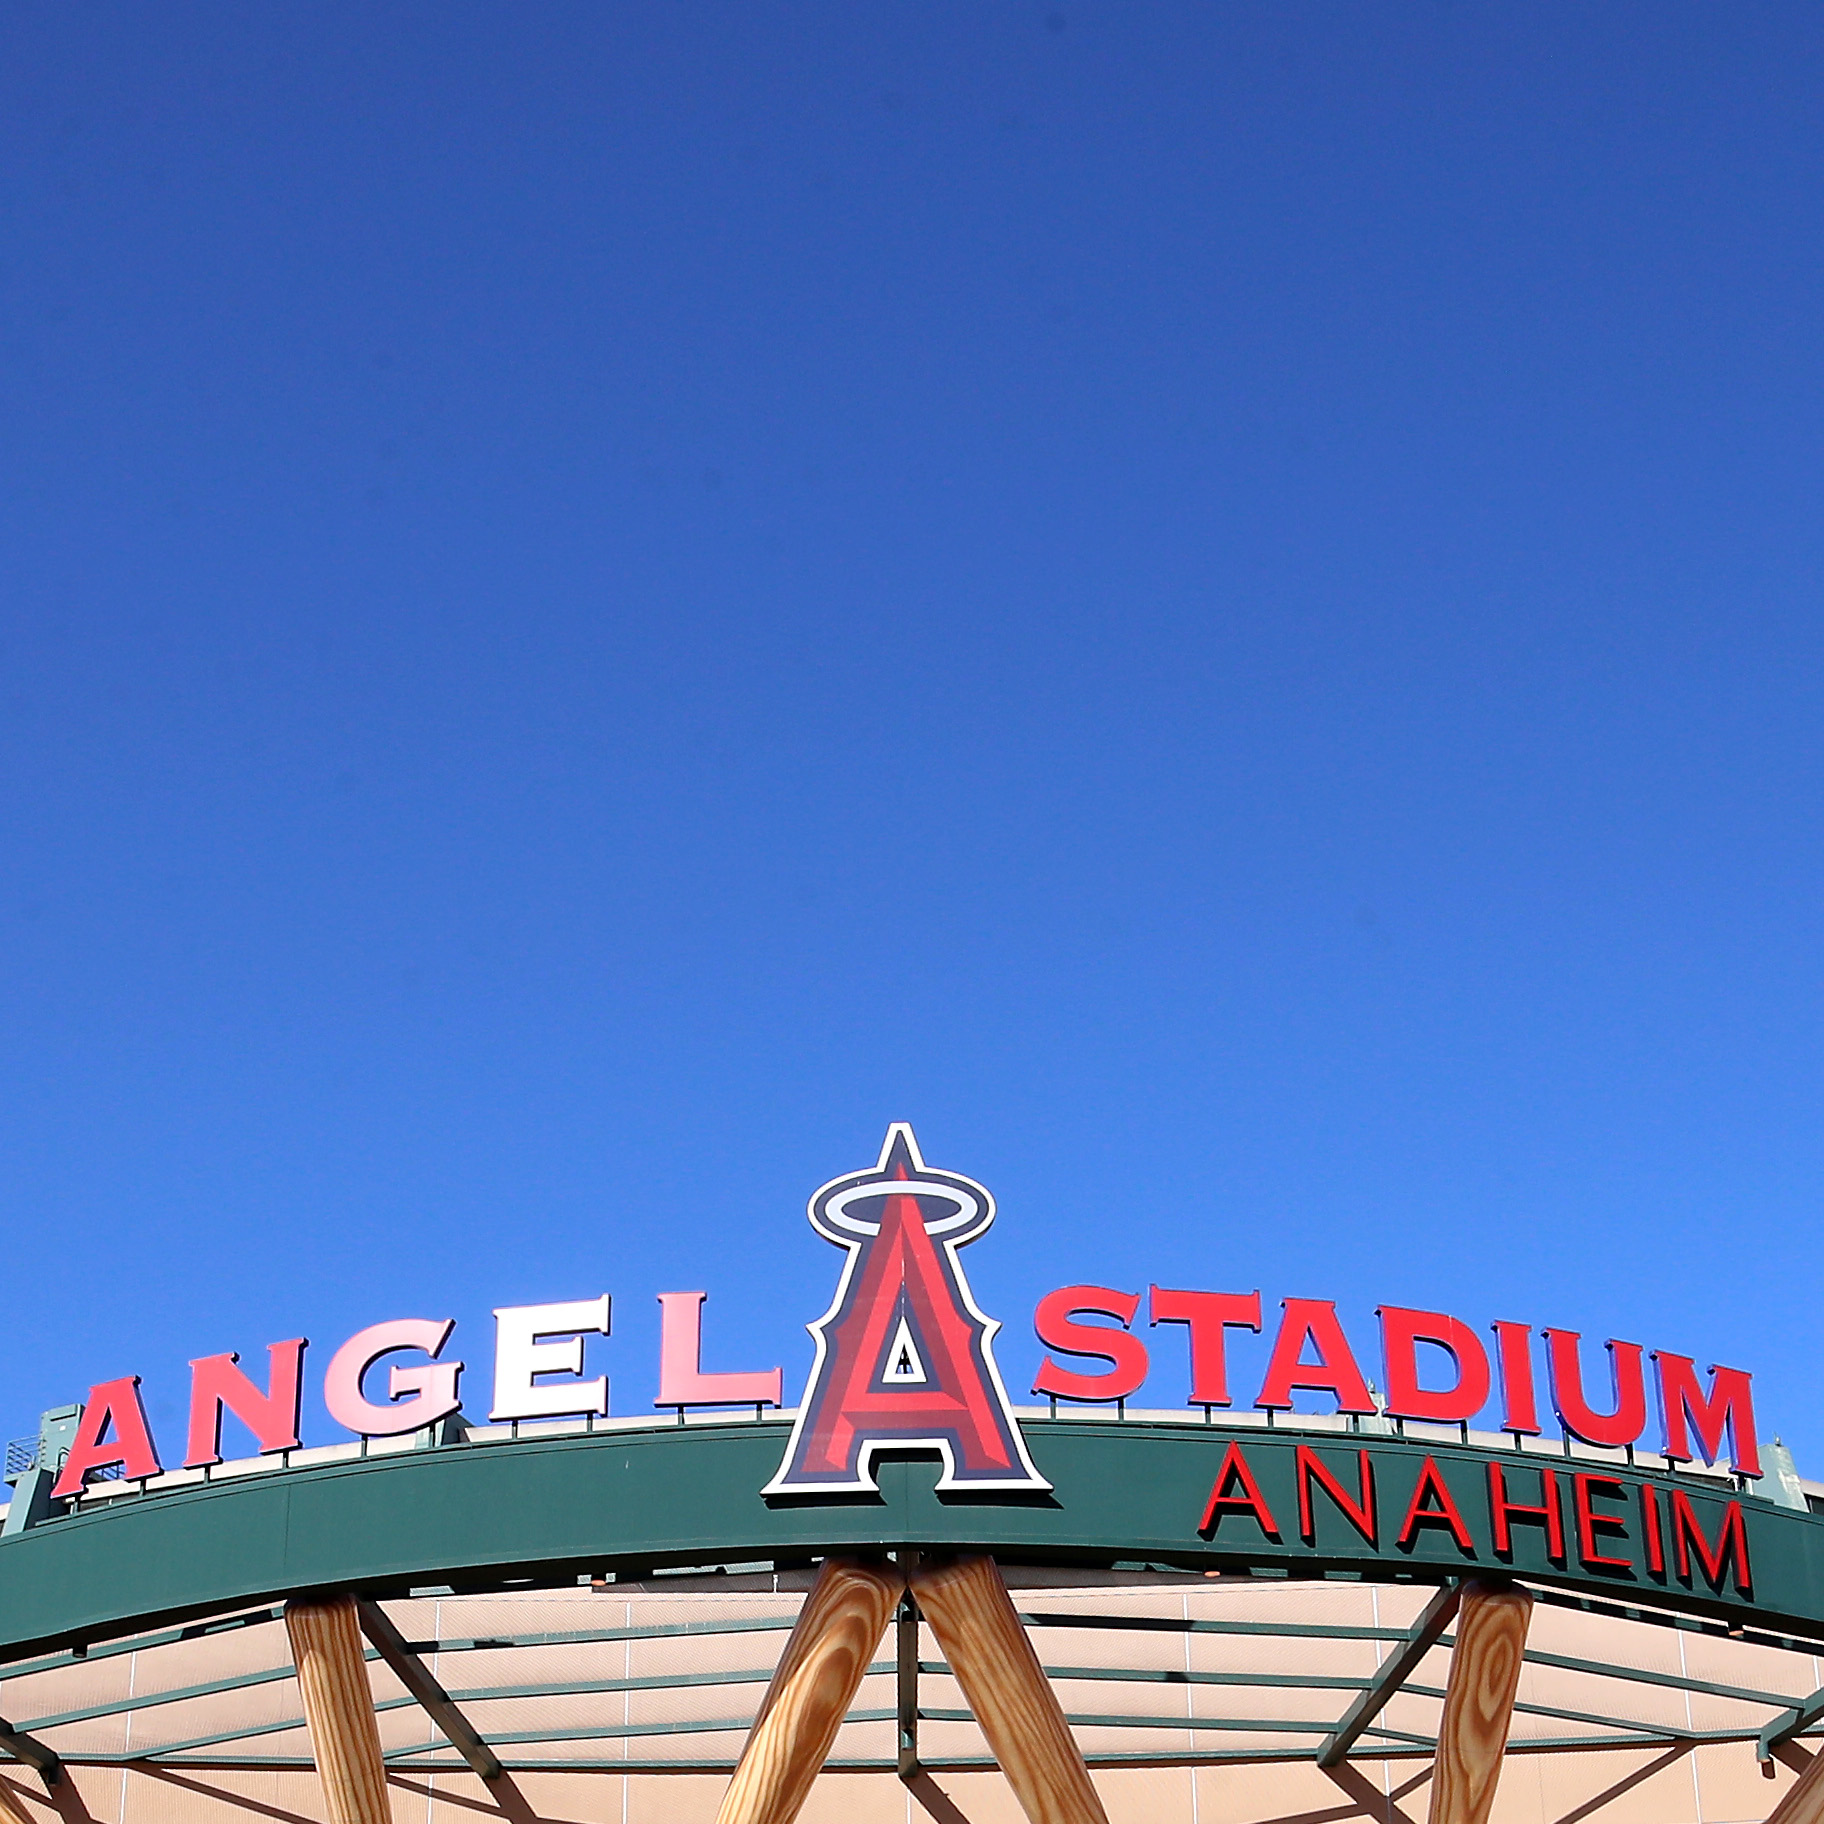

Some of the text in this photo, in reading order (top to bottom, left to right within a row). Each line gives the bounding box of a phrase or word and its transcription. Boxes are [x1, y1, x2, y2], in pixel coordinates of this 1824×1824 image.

[52, 1290, 783, 1499] ANGEL
[1031, 1284, 1764, 1480] STADIUM
[1199, 1439, 1754, 1600] ANAHEIM
